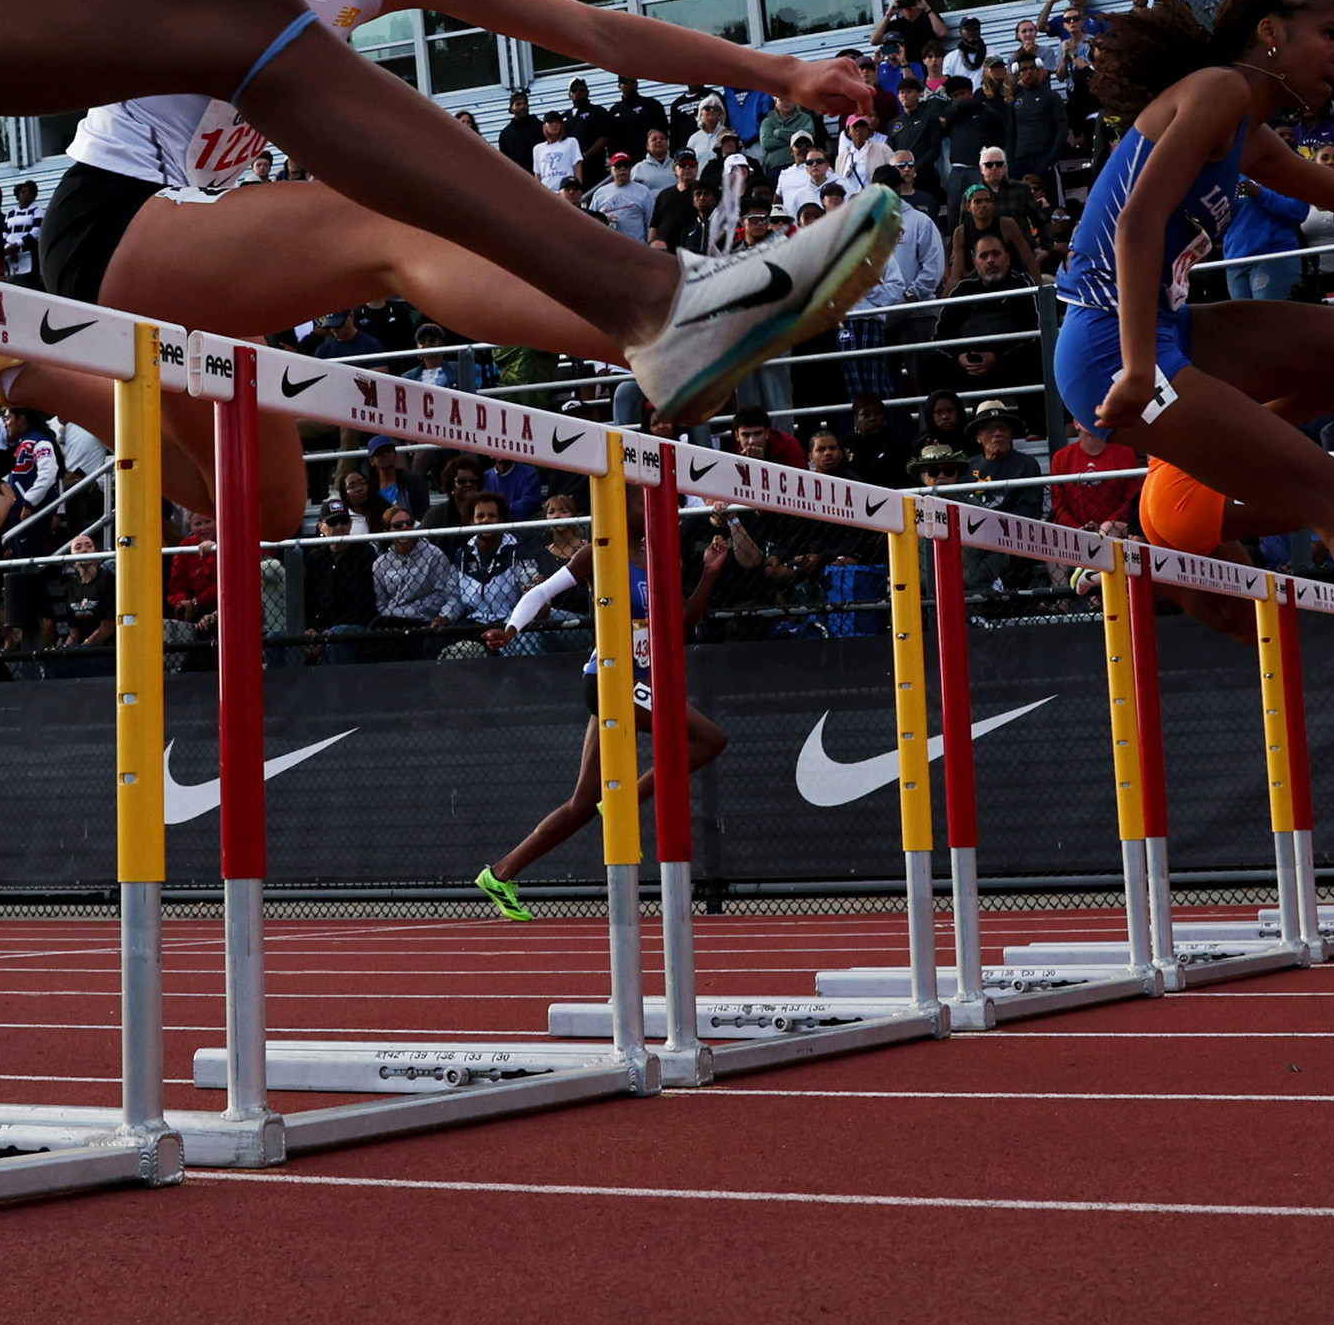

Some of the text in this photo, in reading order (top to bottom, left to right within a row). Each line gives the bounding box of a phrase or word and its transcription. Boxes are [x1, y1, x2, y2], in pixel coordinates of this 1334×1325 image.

[351, 407, 535, 456] HOME OF NATIONAL RECORDS
[733, 486, 756, 501] HOME
